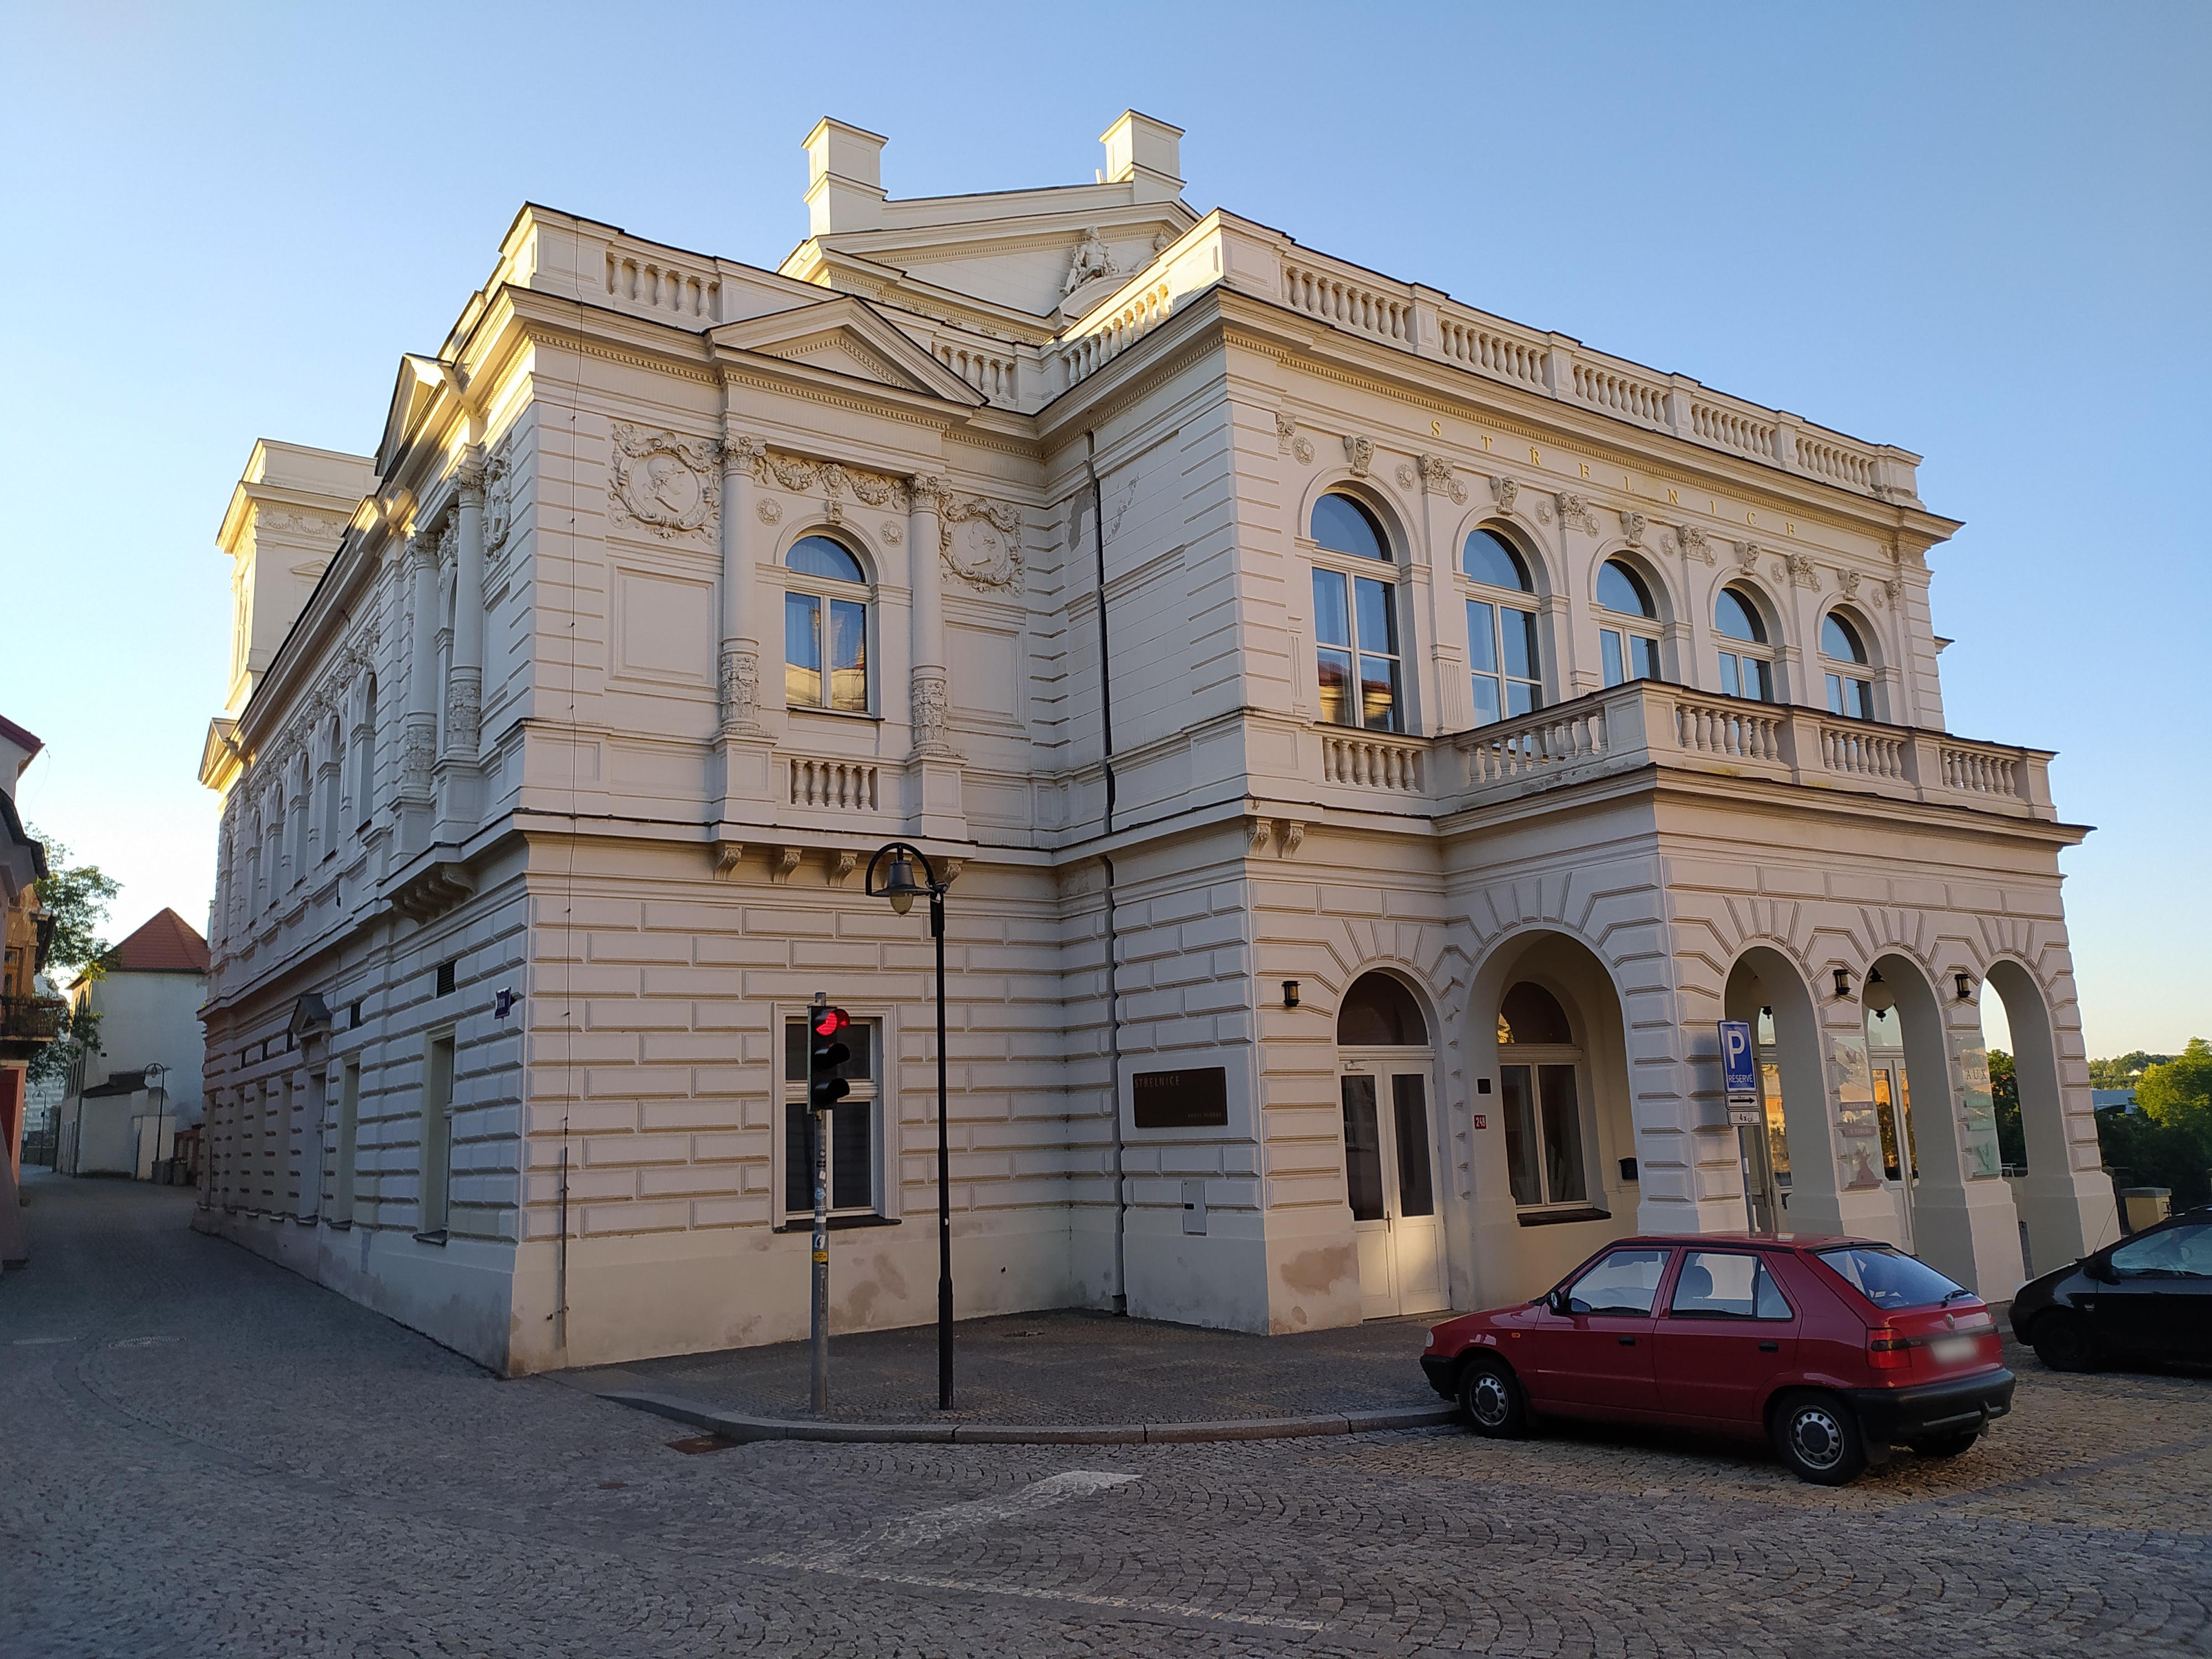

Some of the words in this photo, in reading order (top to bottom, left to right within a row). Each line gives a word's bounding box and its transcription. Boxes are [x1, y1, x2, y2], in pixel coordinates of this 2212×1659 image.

[1431, 420, 1796, 536] STŘELNICE
[1727, 1030, 1745, 1069] P
[1134, 1076, 1180, 1089] STŘELNICE
[1729, 1073, 1753, 1083] RÉSERVÉ
